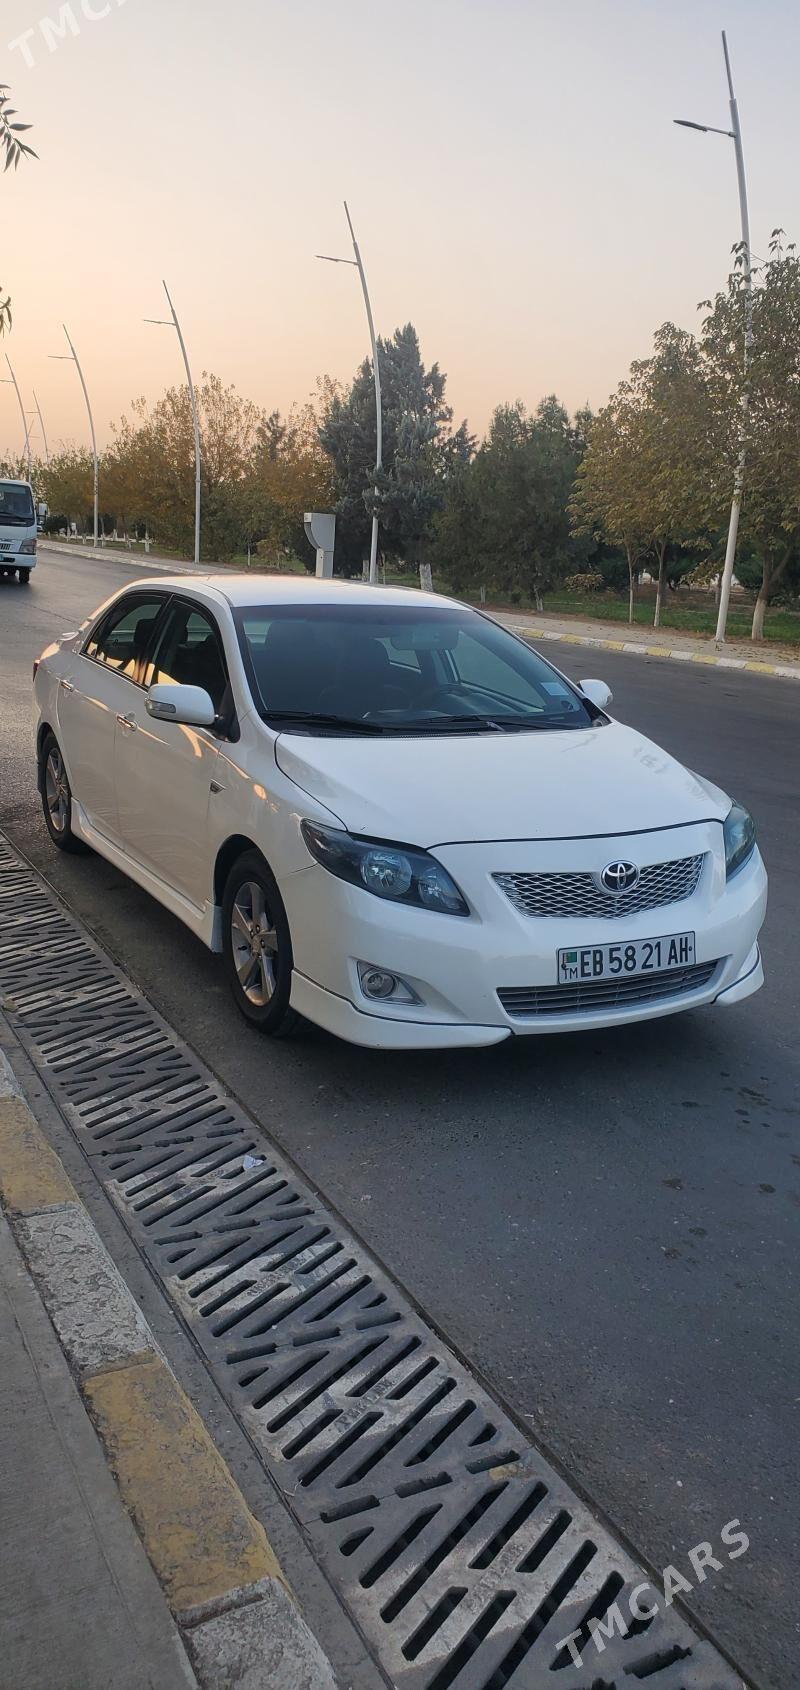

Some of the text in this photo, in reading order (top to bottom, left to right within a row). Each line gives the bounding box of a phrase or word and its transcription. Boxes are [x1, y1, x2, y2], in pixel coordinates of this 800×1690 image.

[563, 936, 689, 979] TM EB 58 21 AH
